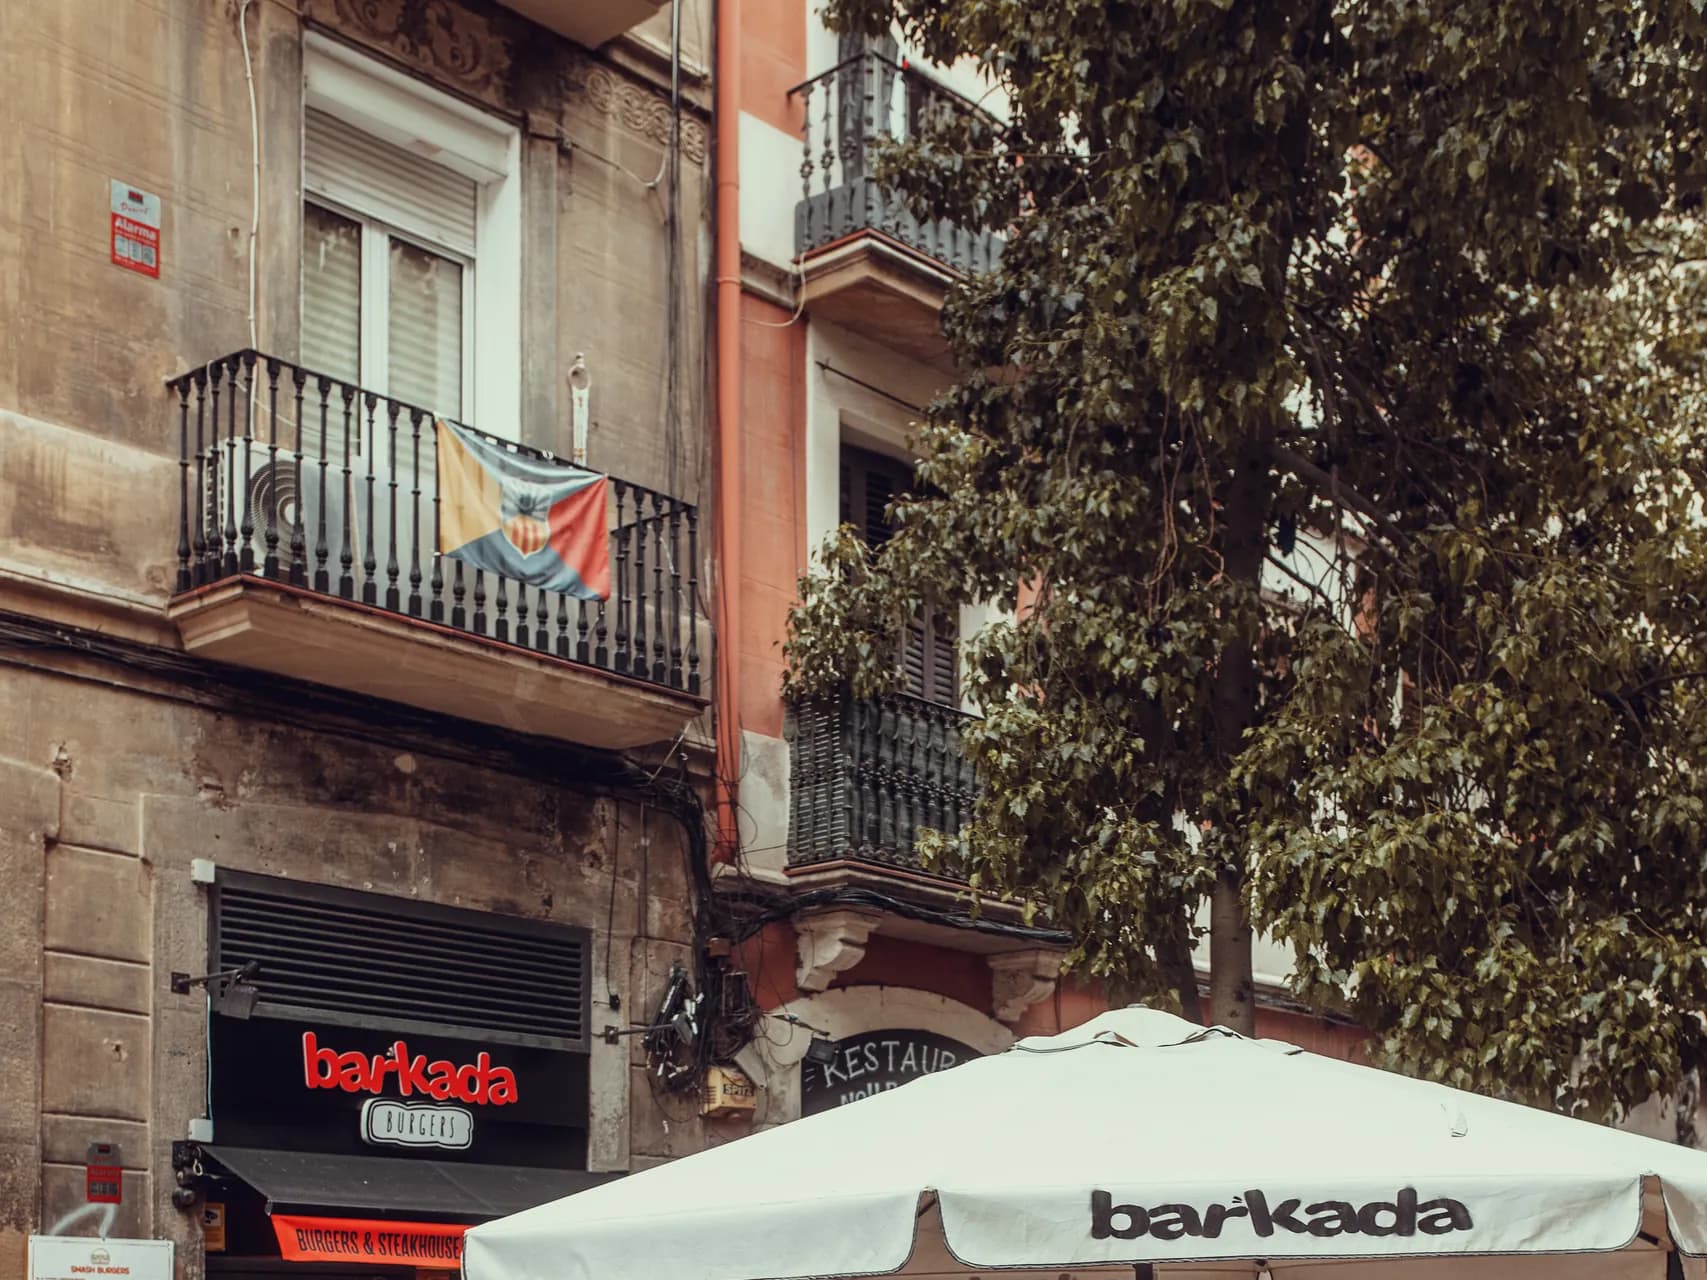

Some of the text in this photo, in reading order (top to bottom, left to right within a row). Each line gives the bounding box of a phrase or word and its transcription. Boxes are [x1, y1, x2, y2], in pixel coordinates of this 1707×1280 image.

[303, 1031, 518, 1105] barkada
[386, 1110, 455, 1138] BURGERS
[1090, 1188, 1474, 1240] barkada
[296, 1228, 461, 1260] BURGERS & STEAKHOUSE
